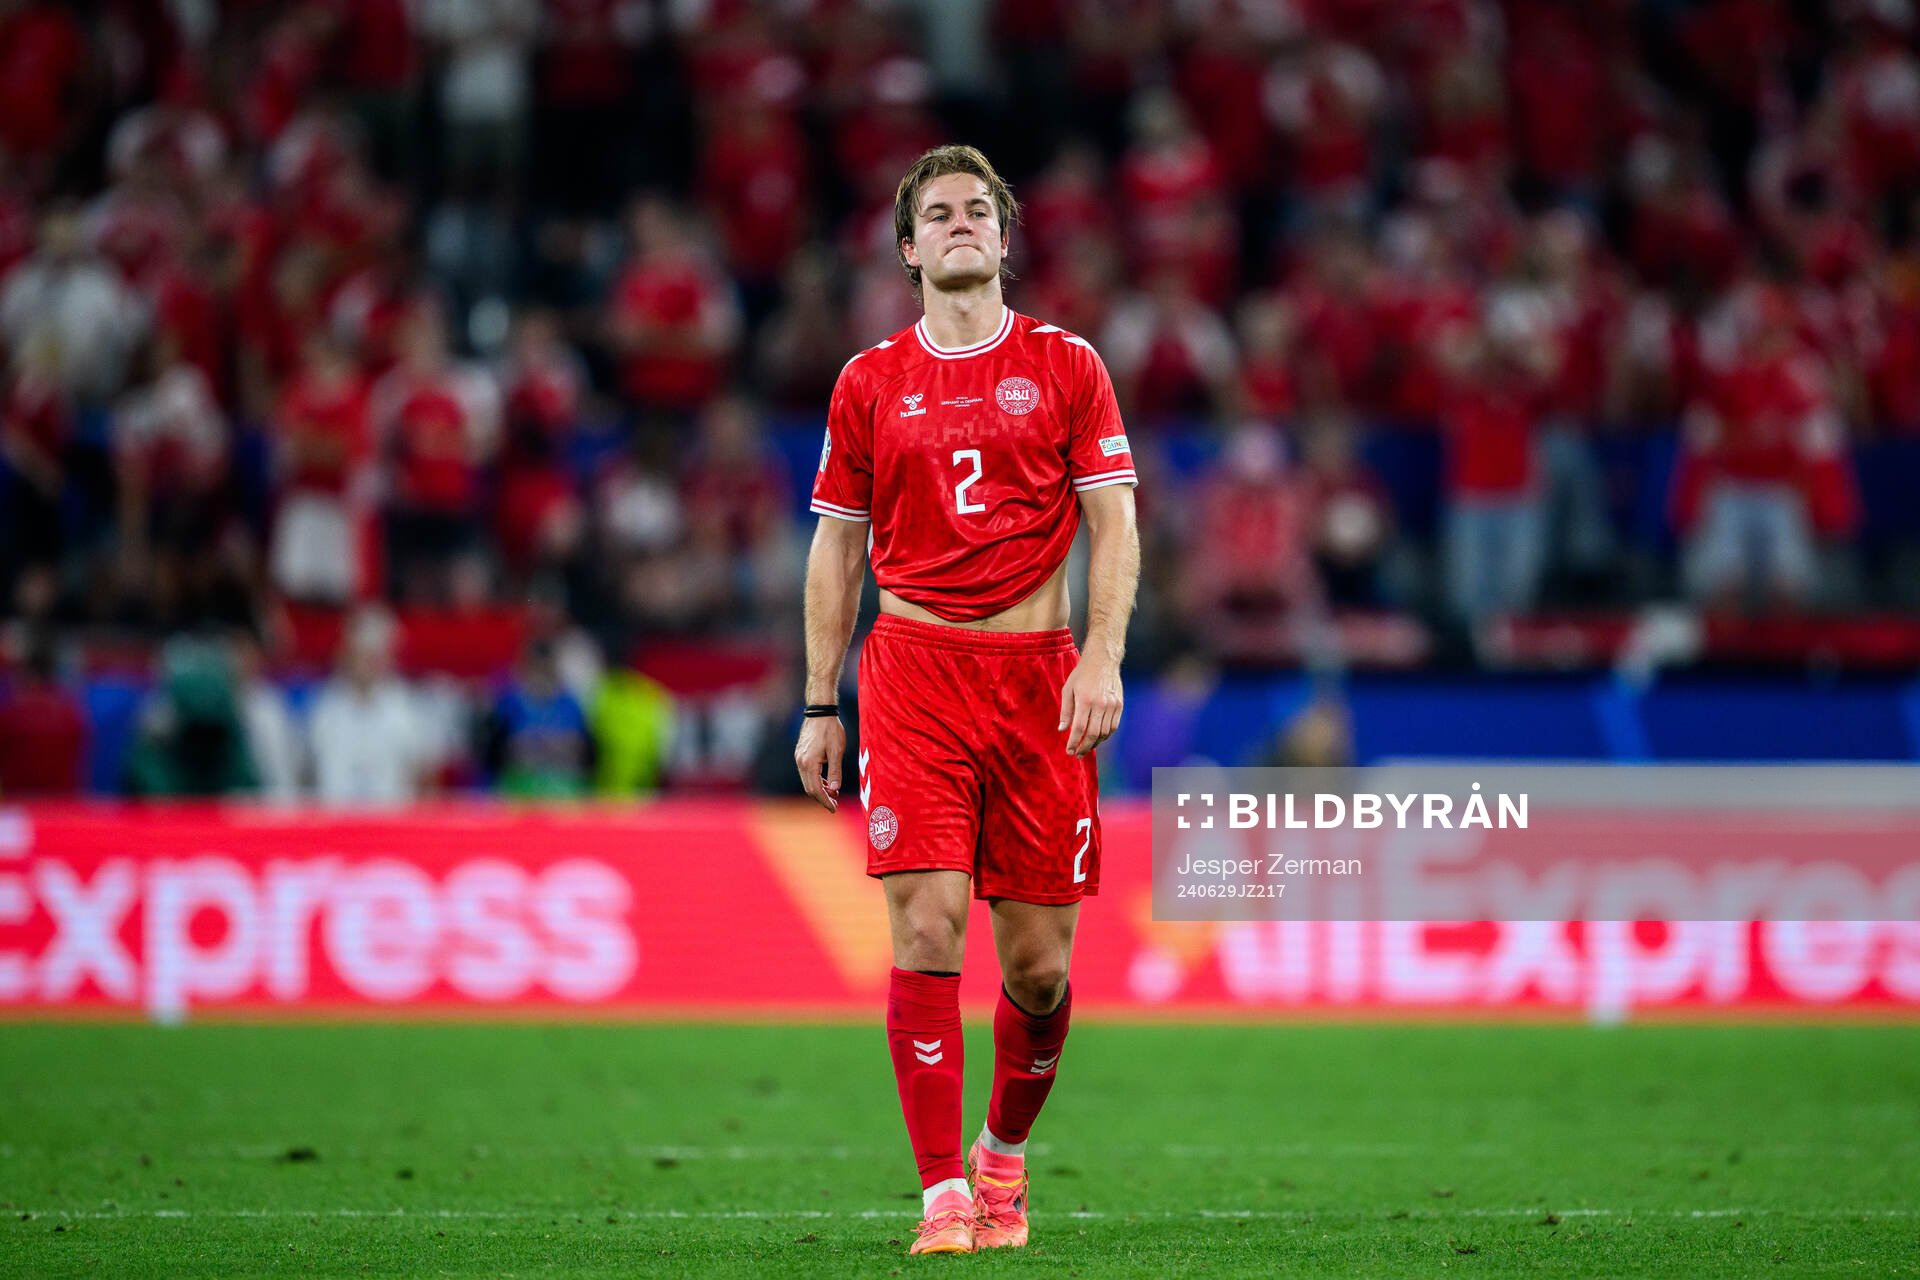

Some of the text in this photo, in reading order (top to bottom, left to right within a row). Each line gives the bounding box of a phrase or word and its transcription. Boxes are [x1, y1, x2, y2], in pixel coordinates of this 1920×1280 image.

[1004, 389, 1030, 401] DBU
[900, 407, 927, 418] hummel
[952, 448, 986, 515] 2
[874, 819, 890, 835] DBU
[1073, 817, 1092, 884] 2
